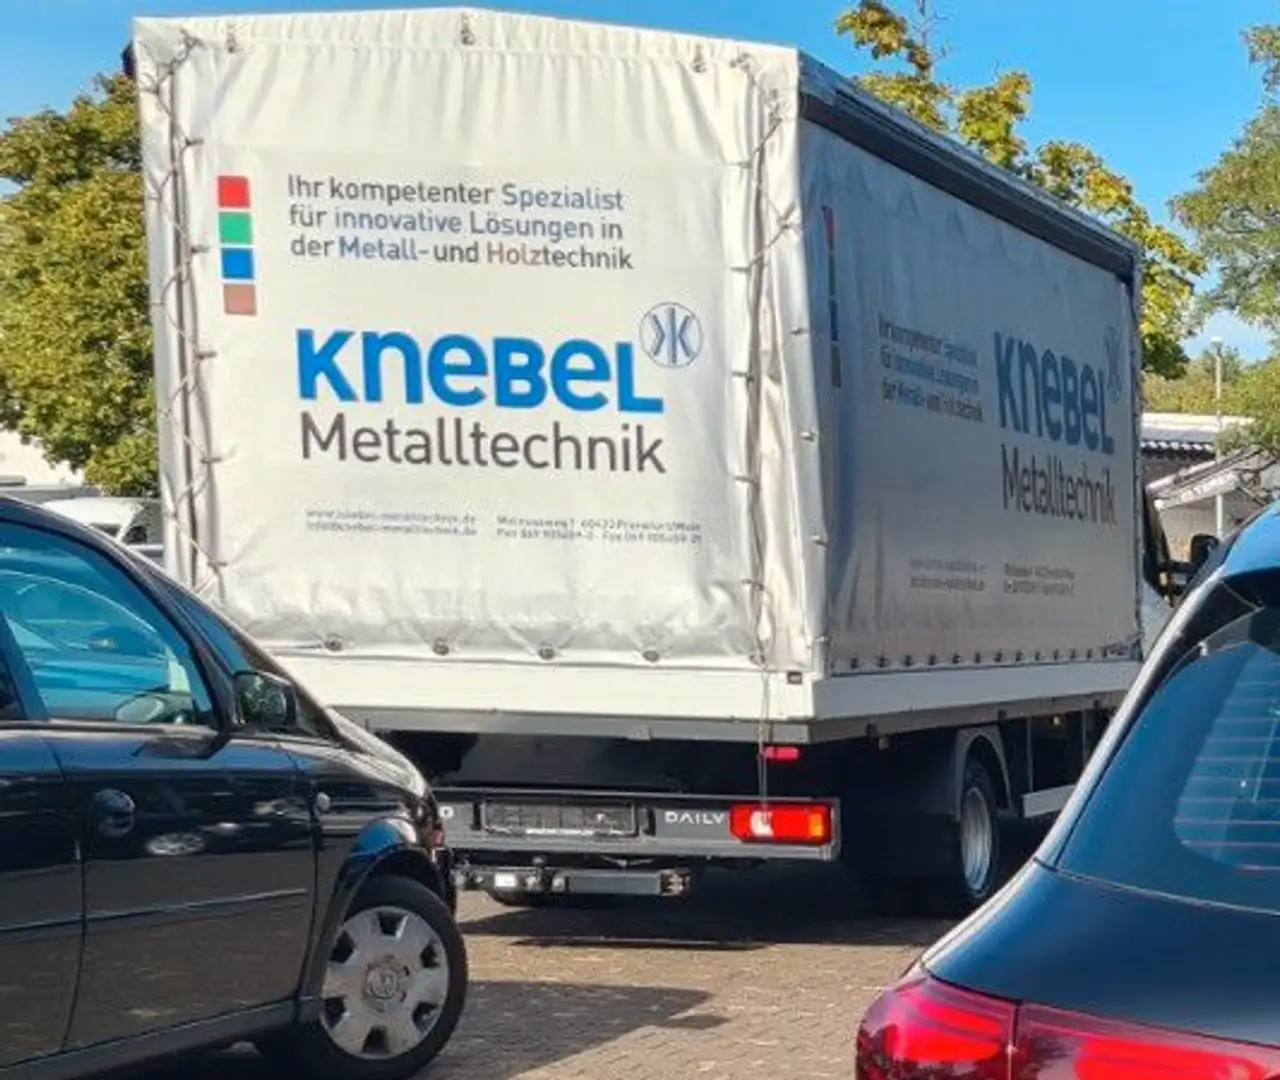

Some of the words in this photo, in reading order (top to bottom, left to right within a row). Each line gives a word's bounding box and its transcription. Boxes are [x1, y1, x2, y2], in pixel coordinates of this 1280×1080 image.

[287, 174, 323, 198] Ihr
[329, 176, 494, 206] kompetenter
[502, 183, 625, 210] Spezialist
[289, 204, 327, 228] für
[335, 205, 462, 234] innovative
[470, 211, 594, 243] Lösungen
[601, 216, 623, 240] in
[290, 235, 333, 258] der
[339, 236, 428, 262] Metall-
[434, 242, 478, 264] und
[487, 242, 633, 270] Holztechnik
[300, 412, 667, 473] Metalltechnik
[1000, 443, 1119, 528] Metalltechnik
[664, 811, 725, 825] DAILY
